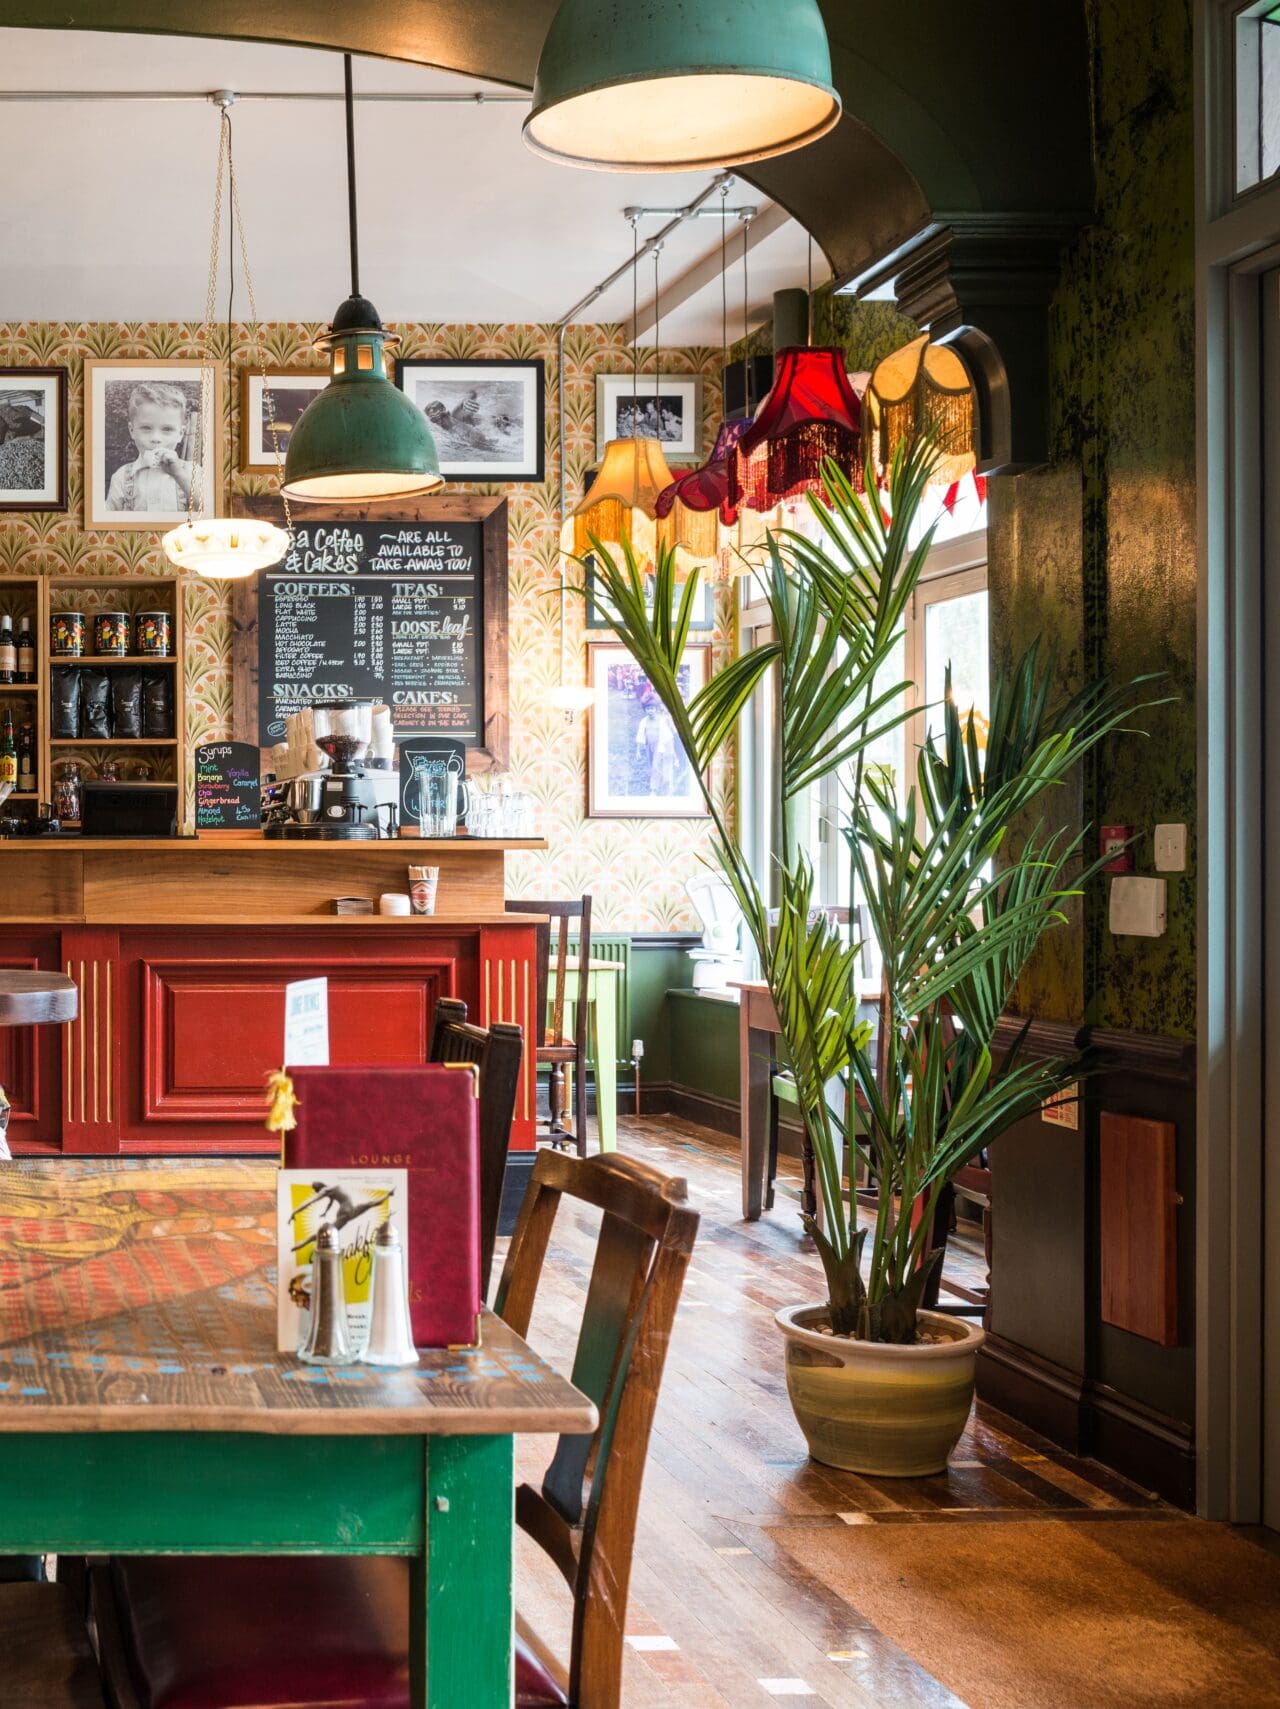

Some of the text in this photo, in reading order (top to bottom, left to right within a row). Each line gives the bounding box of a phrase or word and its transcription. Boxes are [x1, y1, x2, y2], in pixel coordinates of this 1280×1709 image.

[314, 528, 364, 556] Coffee
[397, 530, 452, 543] ARE ALL
[377, 544, 463, 557] AVAILABLE TO
[285, 549, 359, 574] & Cakes
[368, 556, 472, 571] TAKE AWAY TOO!
[391, 614, 472, 640] LOOSE leaf
[198, 746, 233, 764] Syrups
[198, 773, 223, 783] Banana
[226, 768, 250, 778] Vanilla
[232, 778, 258, 789] Caramel
[198, 789, 213, 797] Chai
[198, 796, 240, 808] Gingerbread
[198, 807, 221, 816] Almond
[198, 815, 225, 825] Hazelnut
[351, 1154, 412, 1164] LOUNGE
